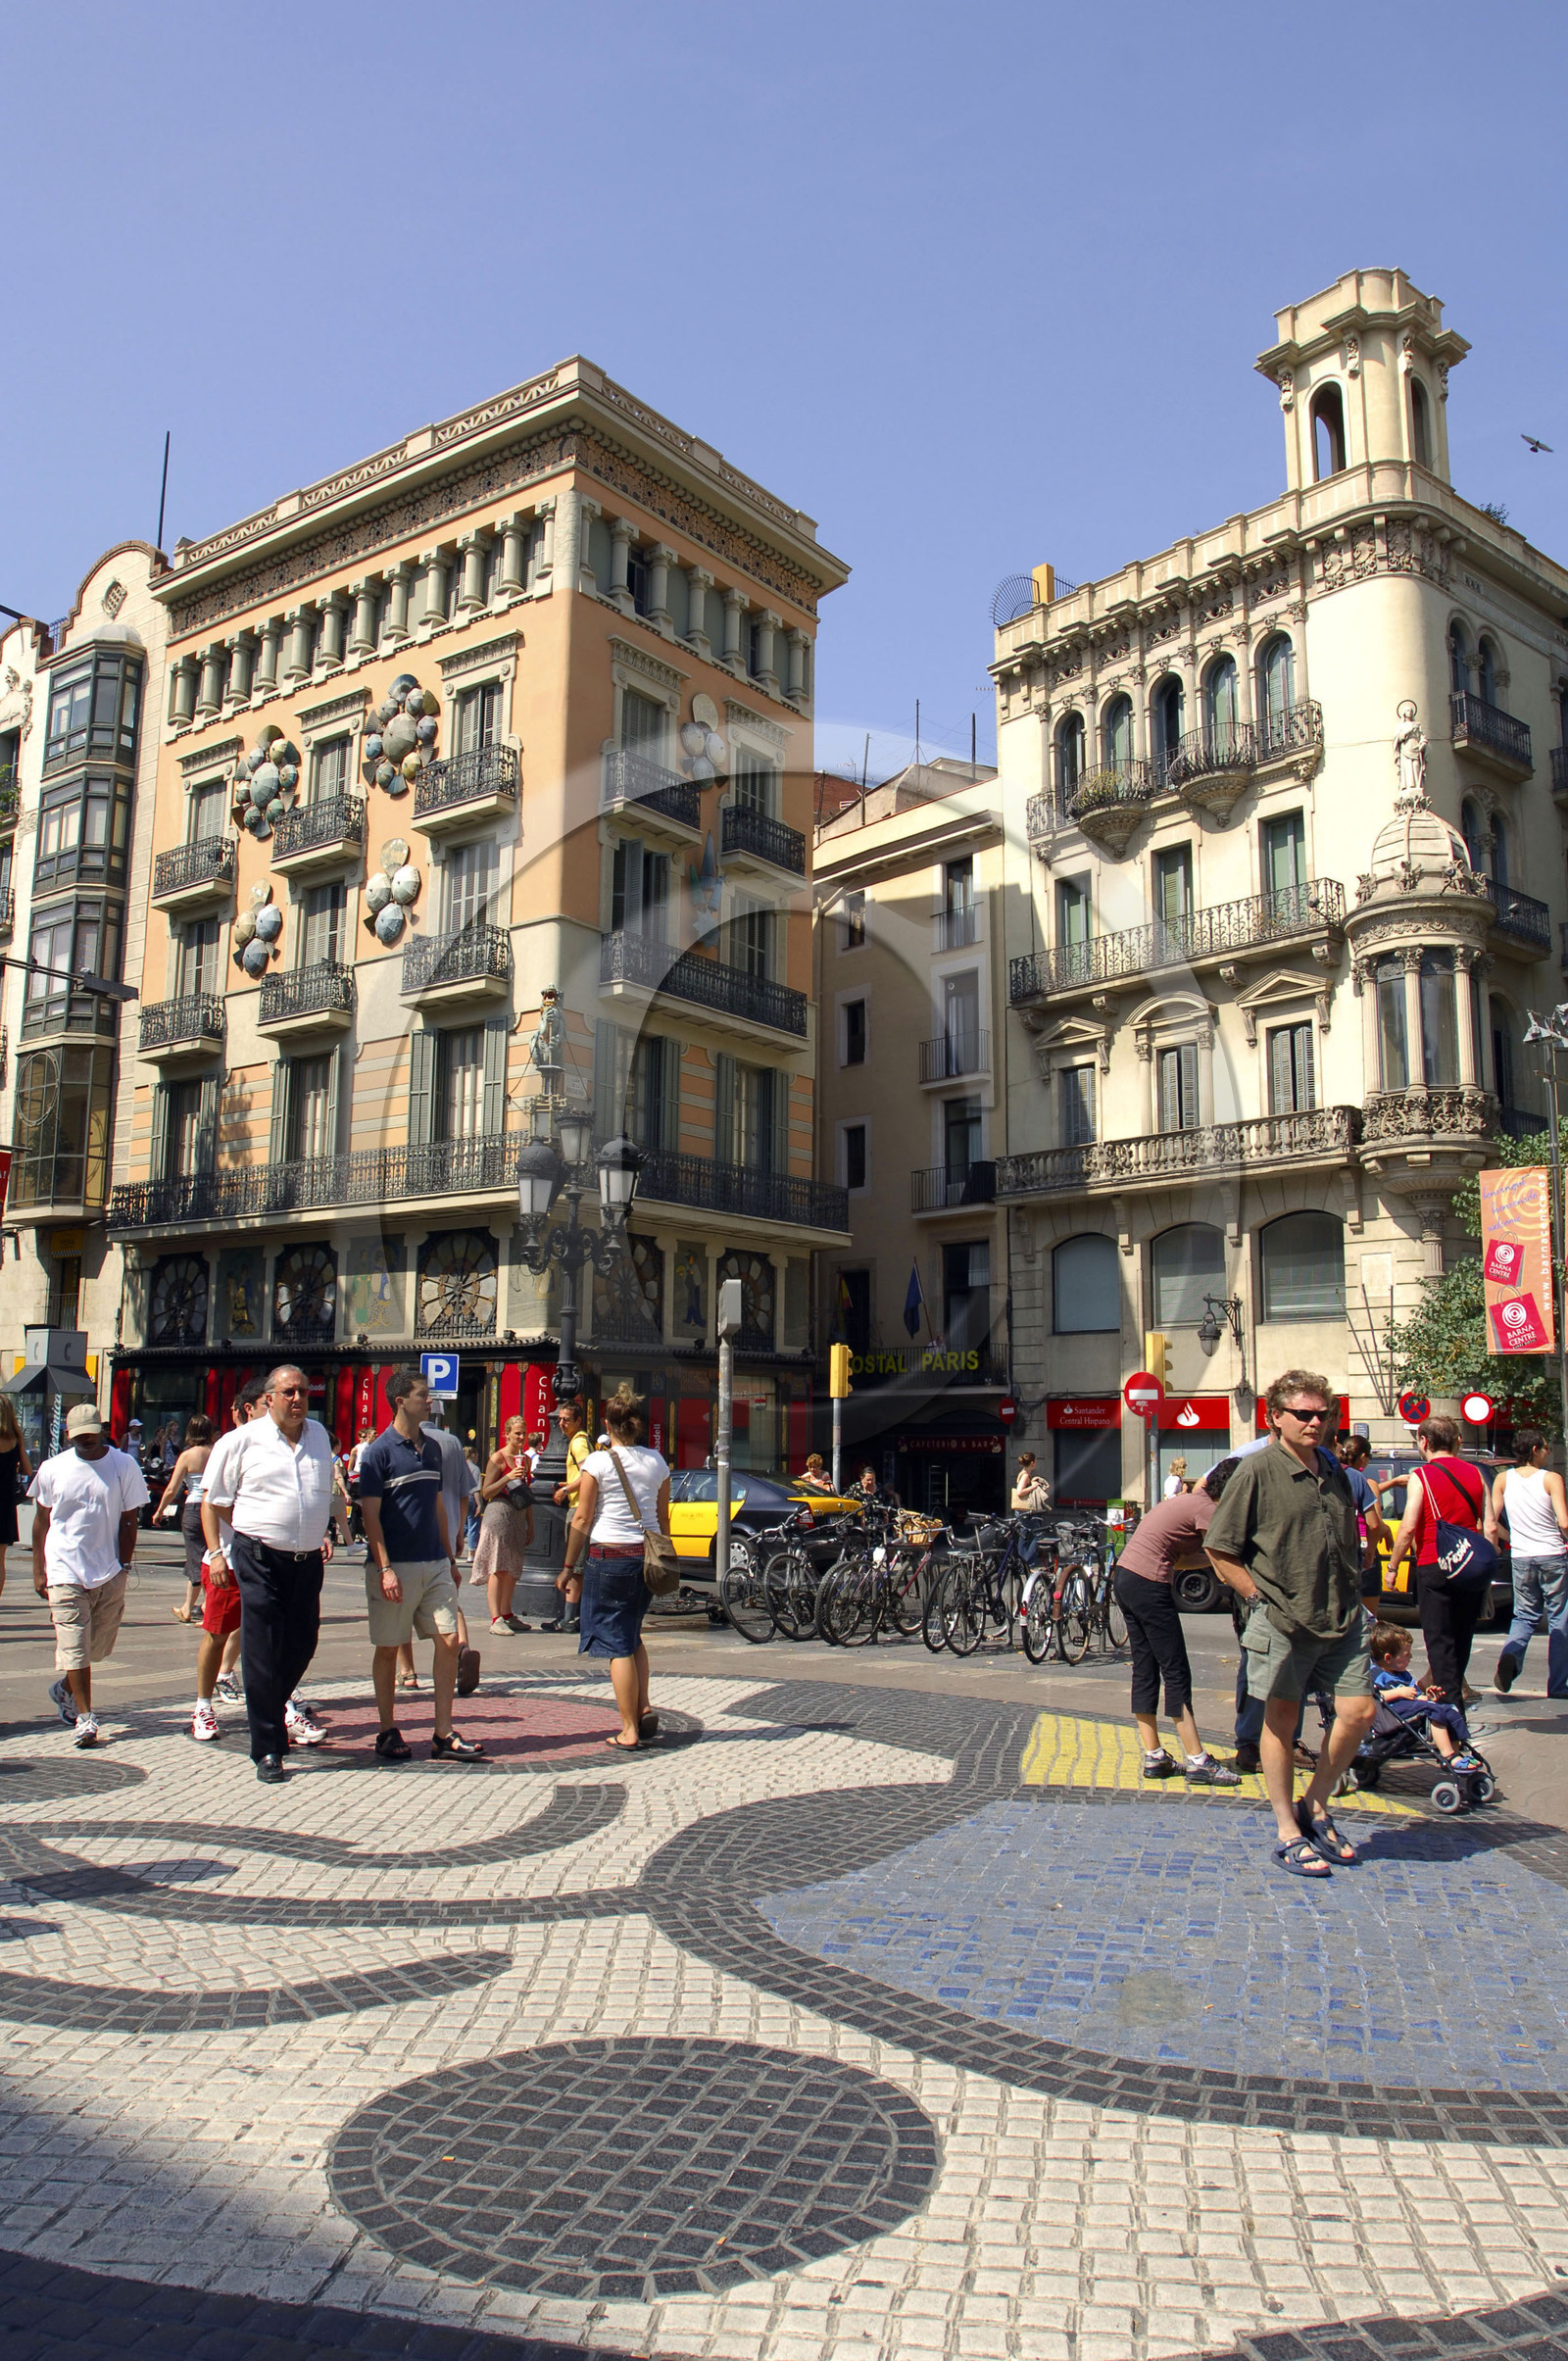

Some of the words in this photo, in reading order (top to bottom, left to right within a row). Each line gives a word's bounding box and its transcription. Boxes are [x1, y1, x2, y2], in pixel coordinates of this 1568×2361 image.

[1488, 1216, 1521, 1232] welcome
[1538, 1174, 1551, 1310] www.barnacentre.es
[1489, 1268, 1510, 1278] CENTRE
[1491, 1261, 1511, 1273] BARNA
[1506, 1324, 1534, 1339] BARNA
[1509, 1331, 1537, 1347] CENTRE
[852, 1353, 907, 1373] OSTAL
[922, 1351, 979, 1371] PARIS
[427, 1358, 451, 1388] P
[1074, 1405, 1105, 1414] Santander
[1059, 1416, 1082, 1425] Central
[1084, 1416, 1110, 1427] Hispano
